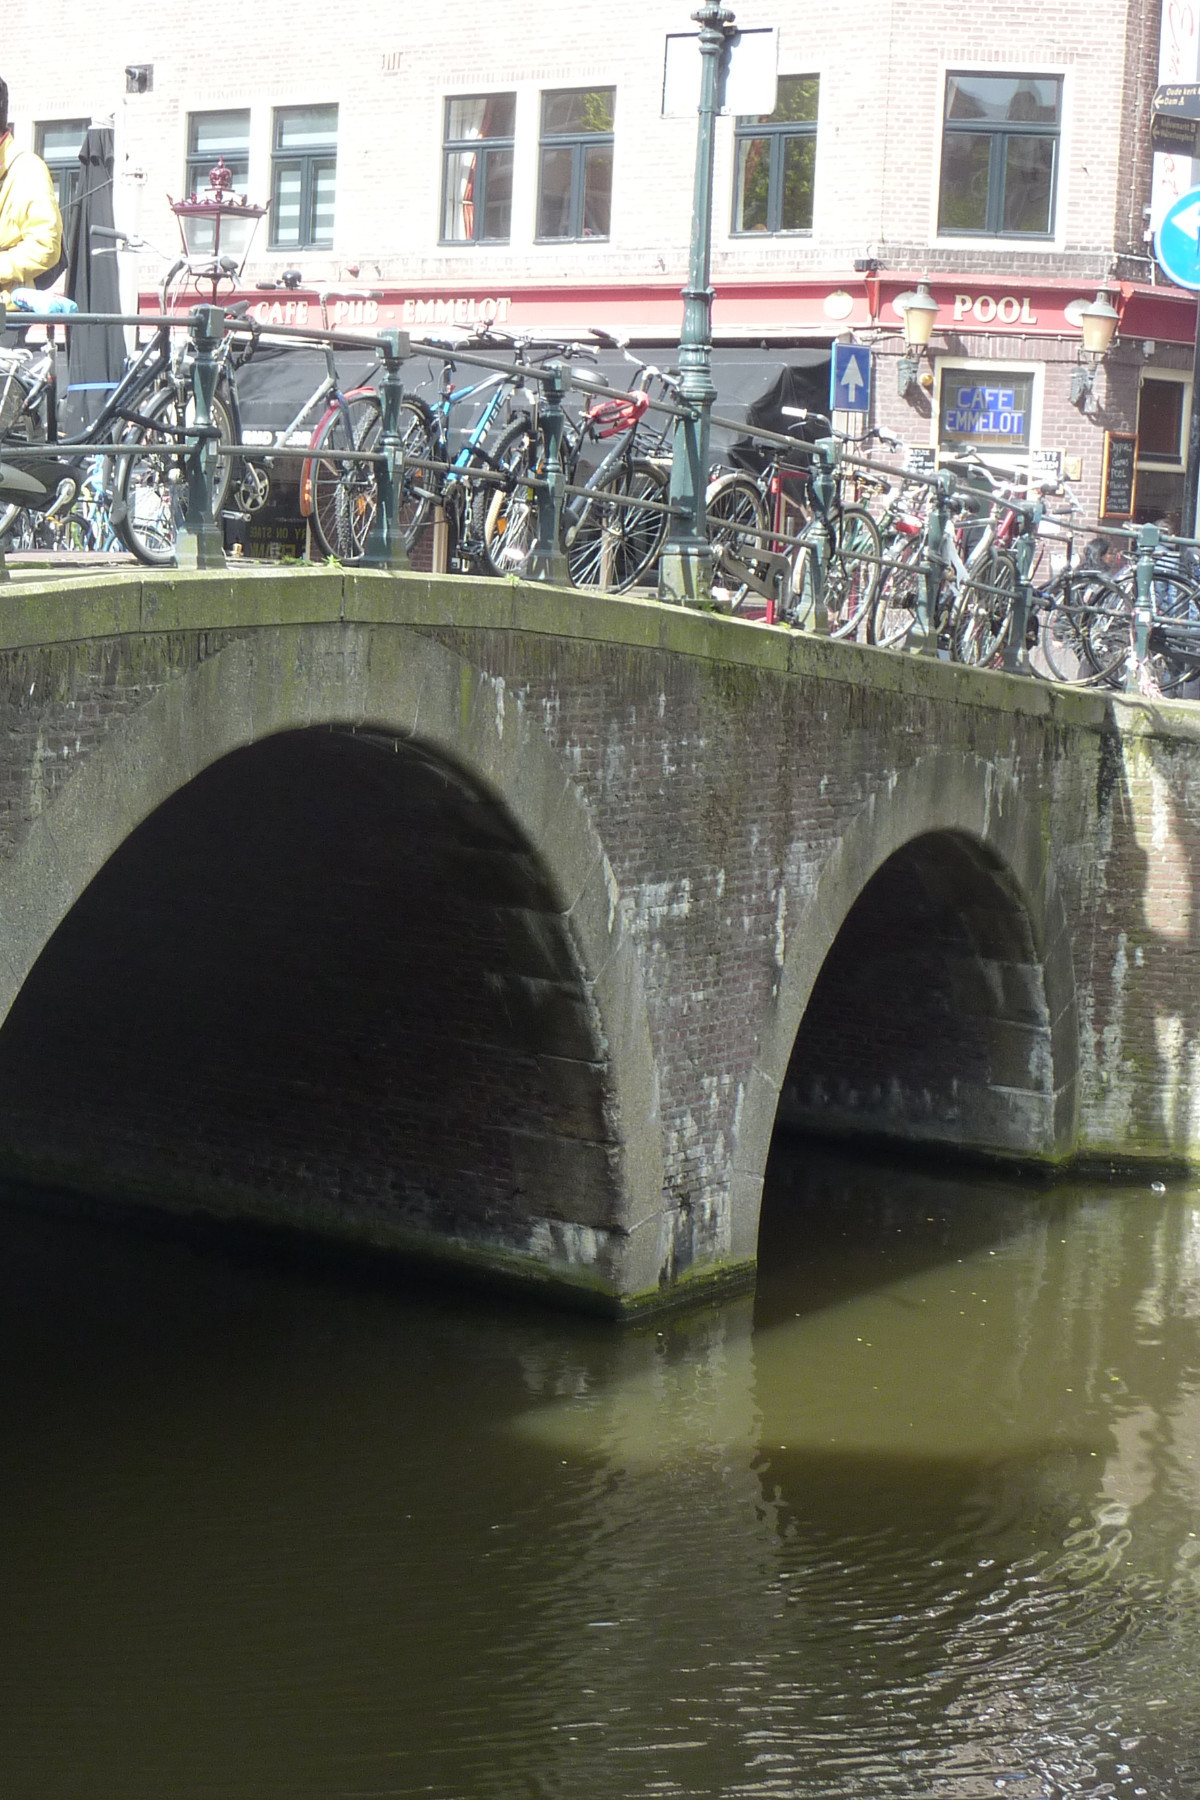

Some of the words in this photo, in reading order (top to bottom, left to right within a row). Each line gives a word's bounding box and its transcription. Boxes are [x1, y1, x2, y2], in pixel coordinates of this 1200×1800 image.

[253, 300, 309, 325] CAFE
[334, 299, 379, 324] PUB
[402, 297, 512, 324] EMMELOT
[953, 294, 1038, 324] POOL
[958, 388, 1013, 410] CAFE
[945, 409, 1023, 433] EMMELOT
